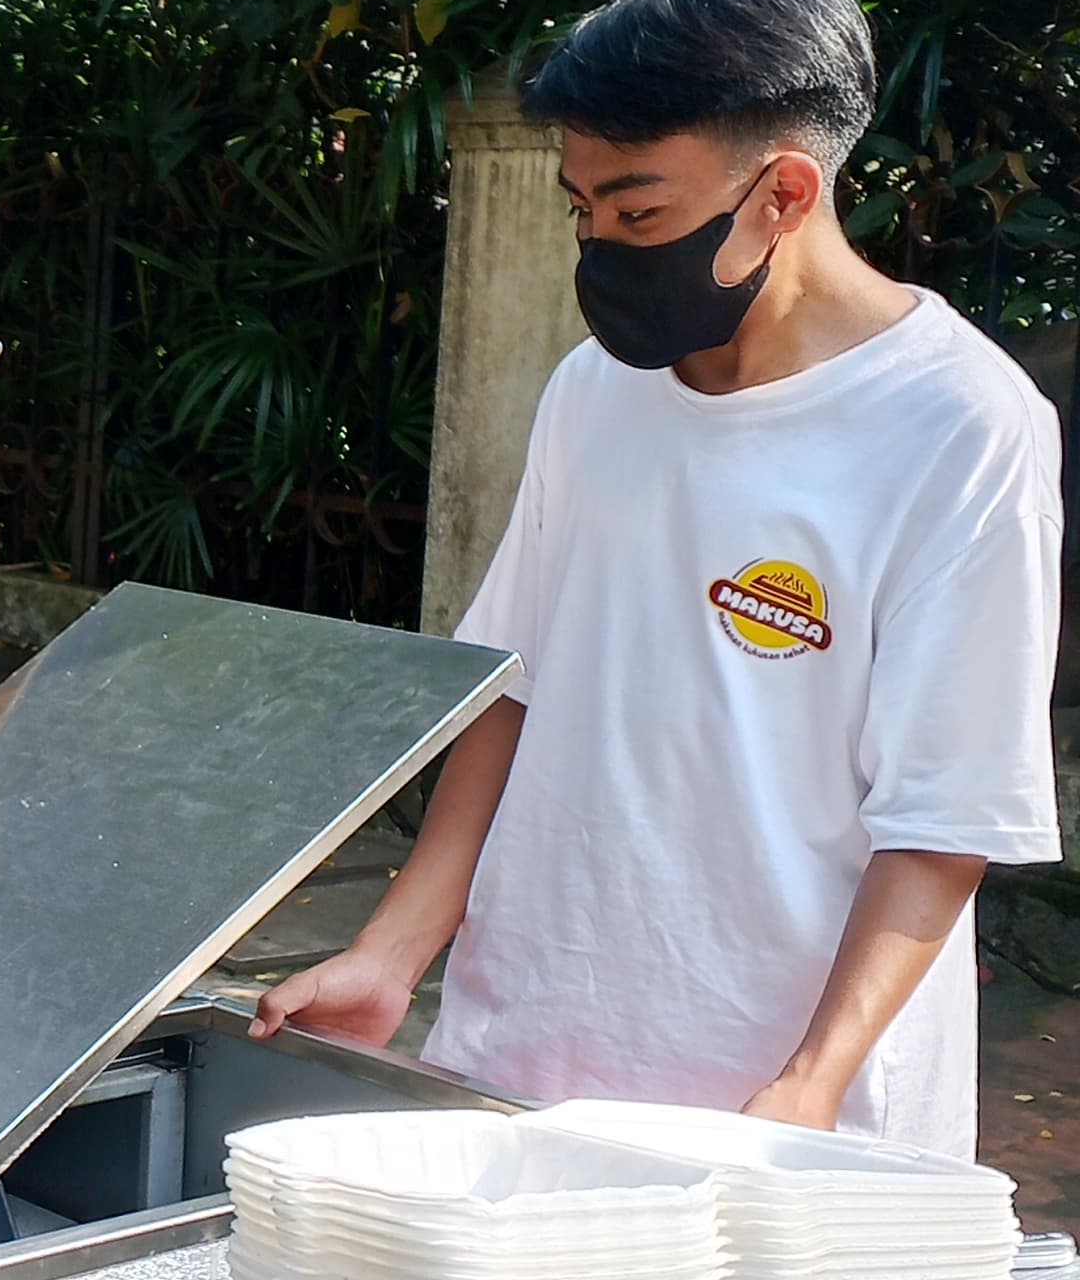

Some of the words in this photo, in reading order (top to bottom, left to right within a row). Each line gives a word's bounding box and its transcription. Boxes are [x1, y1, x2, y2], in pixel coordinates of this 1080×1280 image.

[717, 586, 824, 644] MAKUSA
[742, 643, 780, 660] kukusan
[783, 644, 810, 659] sehat
